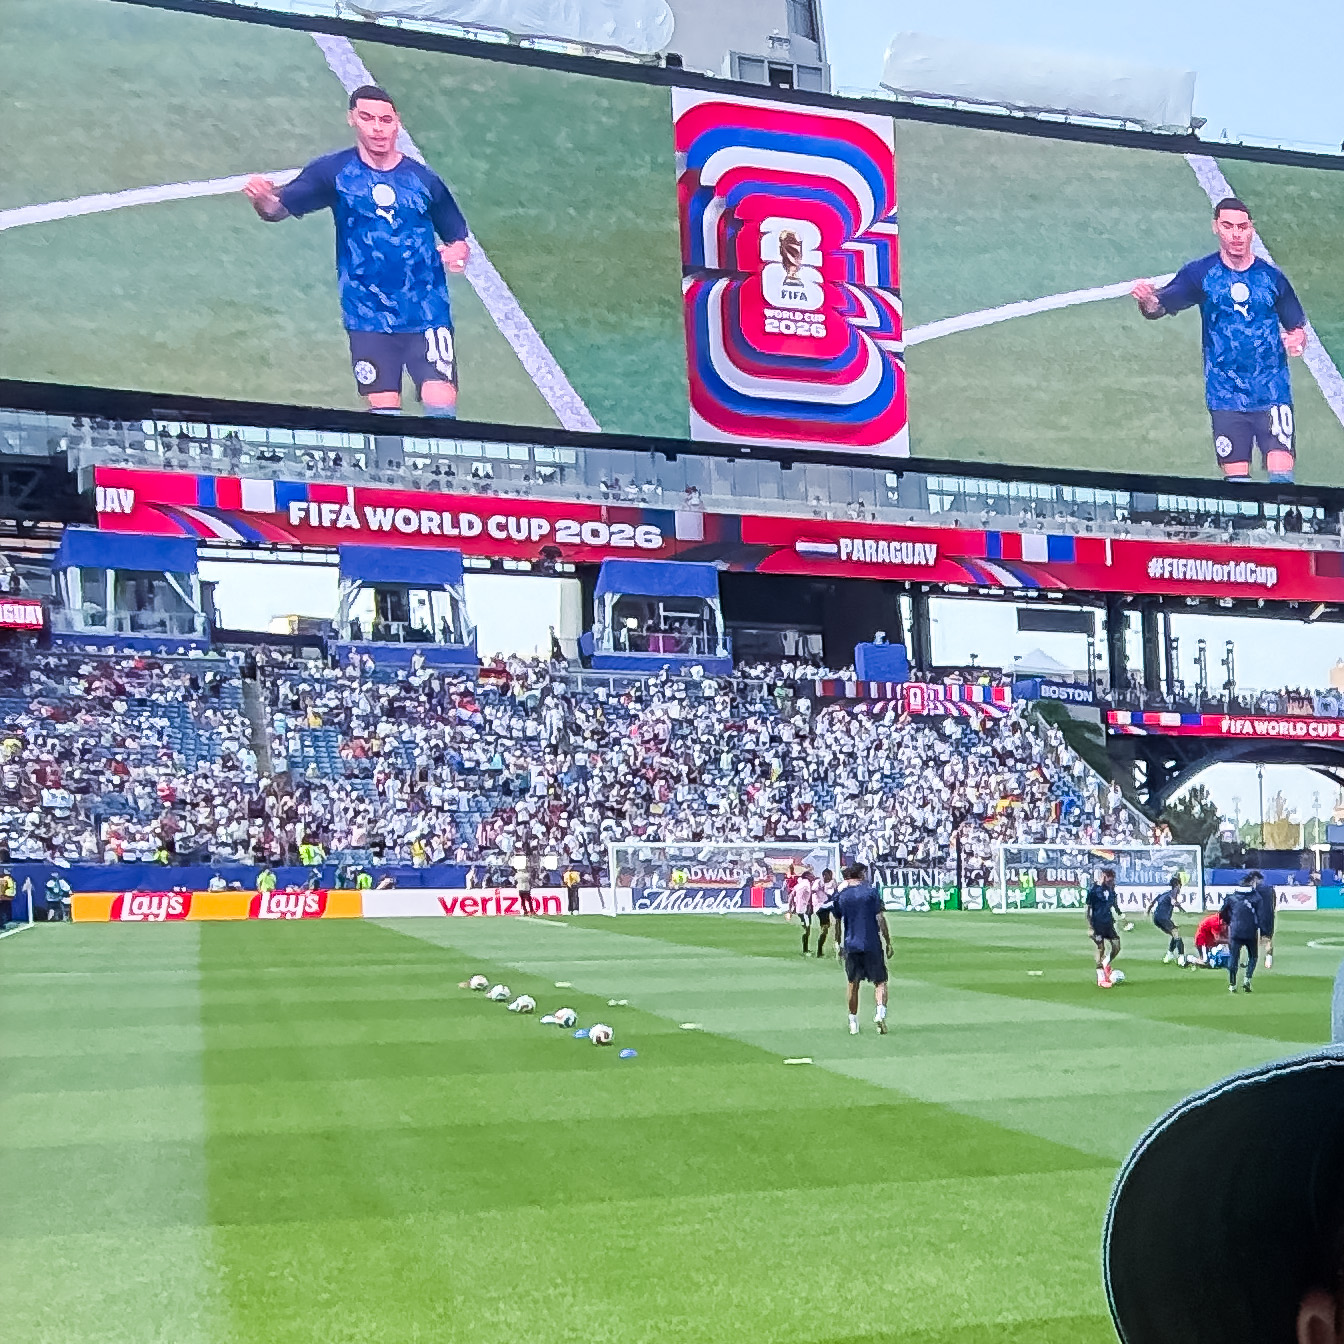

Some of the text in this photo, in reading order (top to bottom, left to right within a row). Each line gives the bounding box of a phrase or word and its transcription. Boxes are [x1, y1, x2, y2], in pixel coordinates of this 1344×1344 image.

[781, 289, 807, 301] FIFA
[764, 308, 803, 320] WORLD
[765, 319, 827, 337] 2026
[289, 502, 663, 549] FIFA WORLD CUP 2026
[840, 538, 937, 567] PARAGUAY
[1147, 559, 1278, 588] #FIFAWorldCup
[1041, 685, 1093, 702] BOSTON
[1222, 715, 1253, 733] FIFA
[1256, 719, 1308, 736] WORLD
[1309, 720, 1337, 737] CUP
[121, 892, 184, 921] Lay's
[259, 892, 318, 920] Lay's
[636, 888, 744, 912] Michelob
